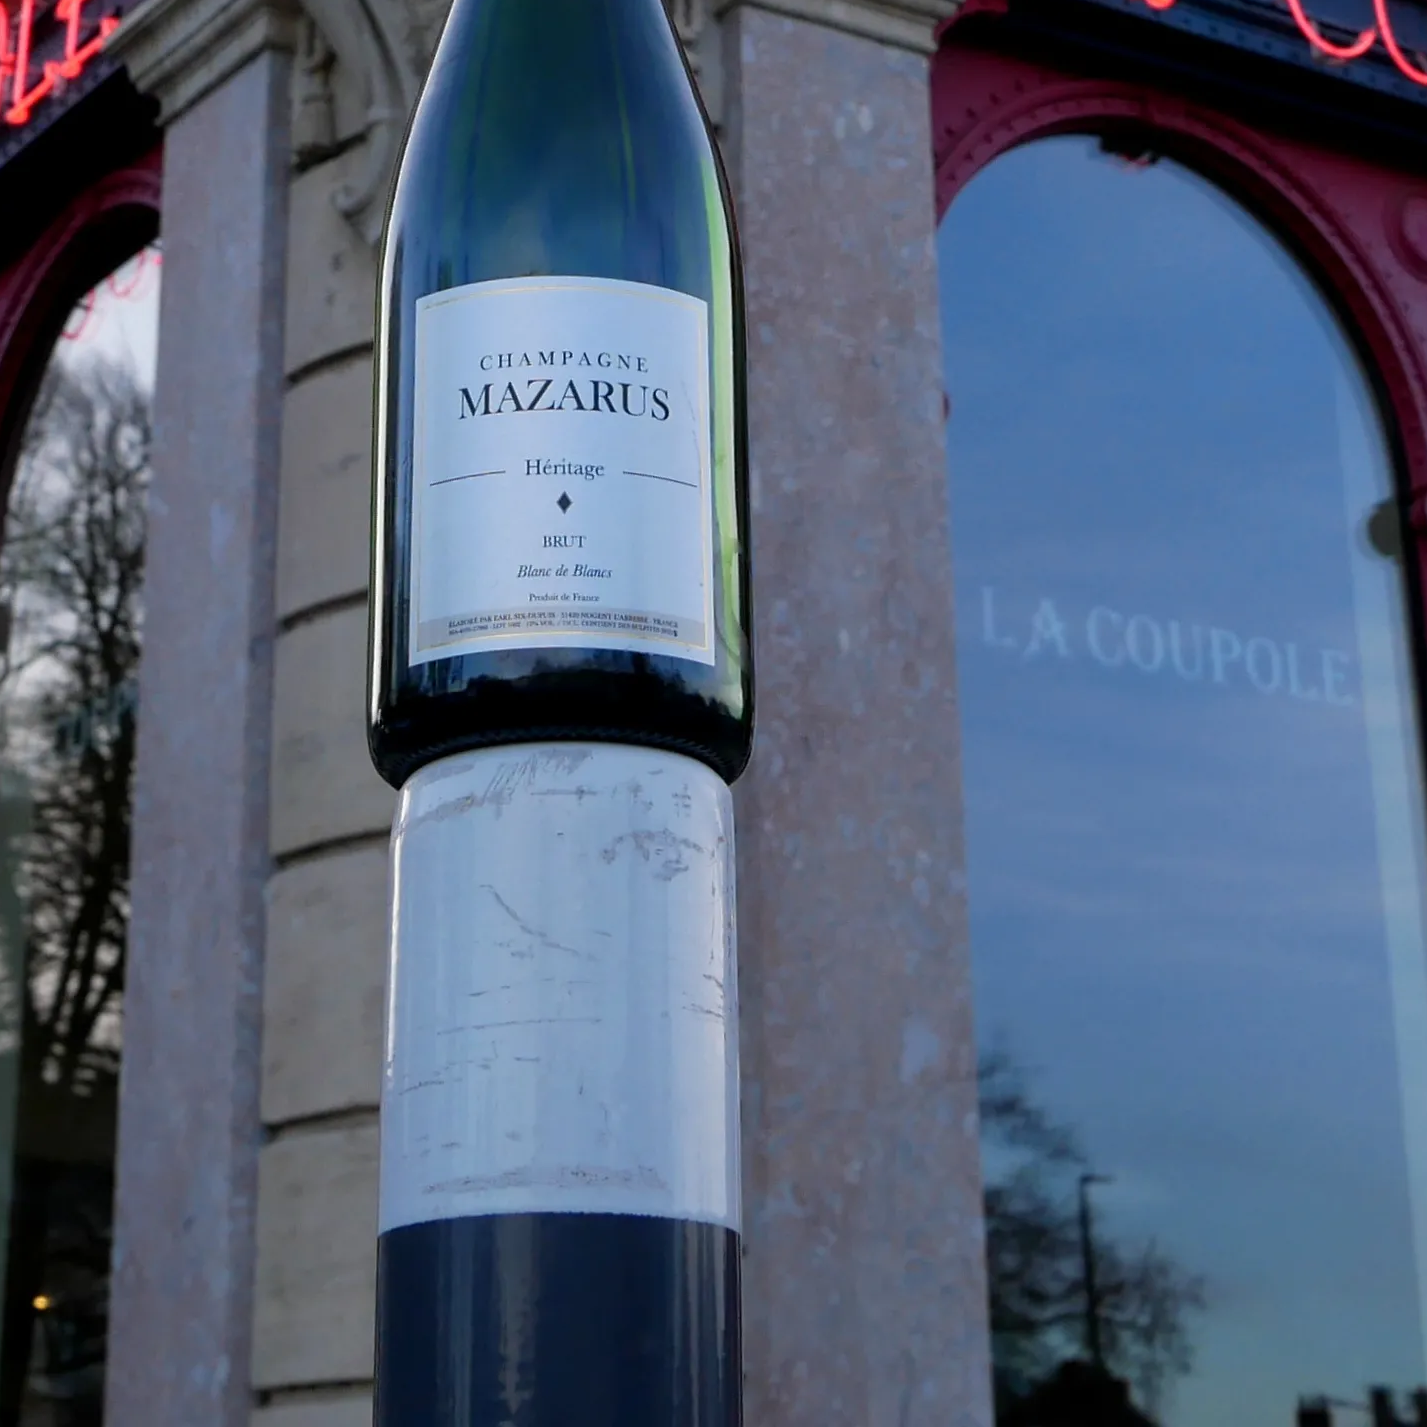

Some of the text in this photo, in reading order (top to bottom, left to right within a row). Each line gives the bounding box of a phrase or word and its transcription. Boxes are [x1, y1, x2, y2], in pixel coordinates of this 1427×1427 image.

[479, 350, 650, 373] CHAMPAGNE
[458, 379, 671, 421] MAZARUS
[525, 458, 605, 480] Héritage
[542, 534, 587, 548] BRUT
[517, 563, 613, 578] Blanc de Blancs
[529, 592, 600, 602] Produit de France
[980, 585, 1355, 707] LA COUPOLE
